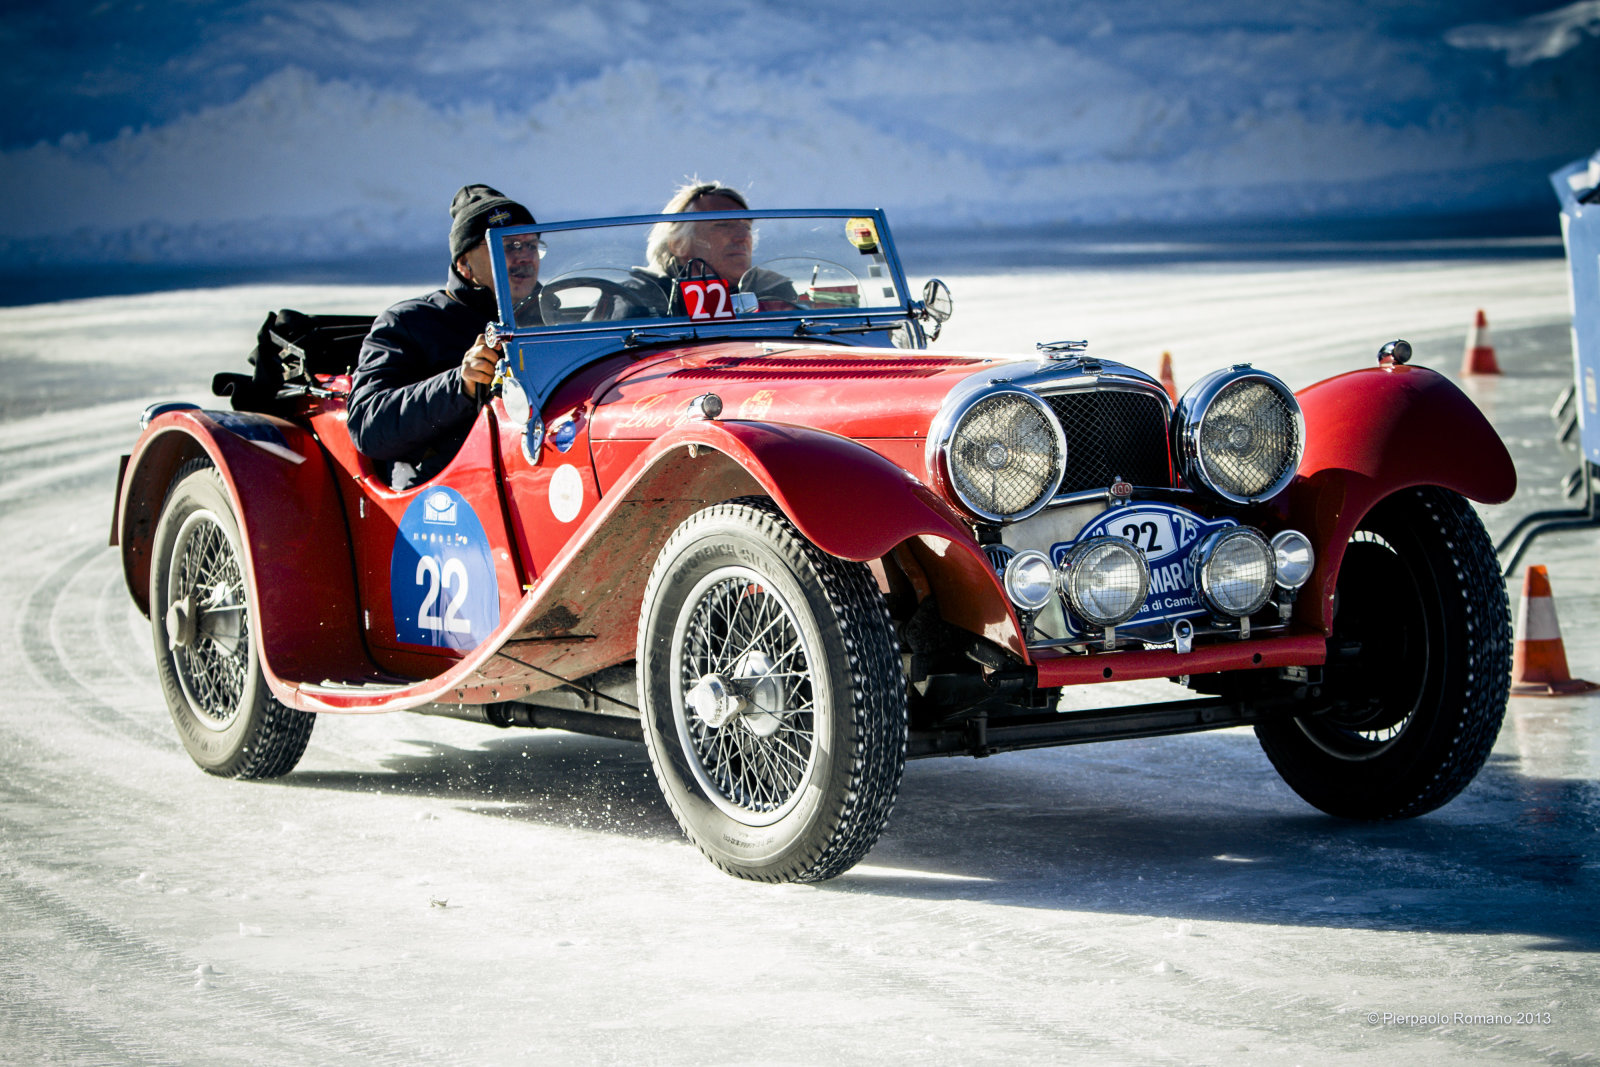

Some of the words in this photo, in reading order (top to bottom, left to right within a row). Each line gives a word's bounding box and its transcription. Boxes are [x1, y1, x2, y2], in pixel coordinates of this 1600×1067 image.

[684, 283, 733, 320] 22
[1122, 521, 1163, 553] 22
[415, 555, 471, 634] 22
[1152, 599, 1163, 611] di
[1164, 595, 1198, 608] Camp
